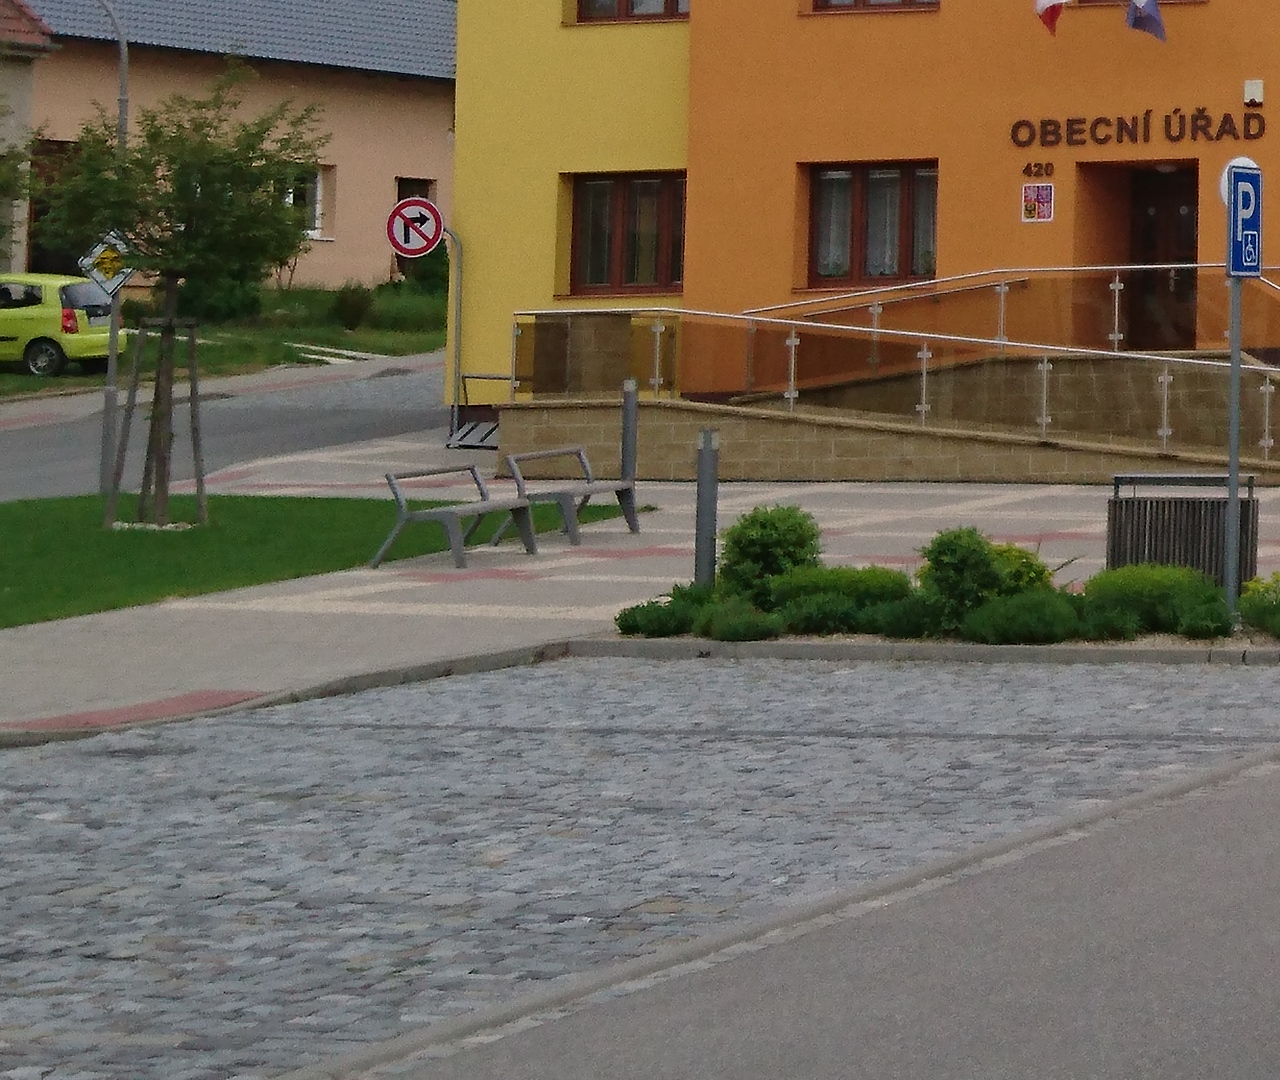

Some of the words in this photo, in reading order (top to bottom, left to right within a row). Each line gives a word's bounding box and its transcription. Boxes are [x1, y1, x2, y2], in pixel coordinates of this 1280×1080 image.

[1011, 109, 1152, 148] OBECNÍ
[1164, 107, 1267, 143] ÚŘAD
[1022, 162, 1055, 178] 420
[1237, 181, 1256, 242] P
